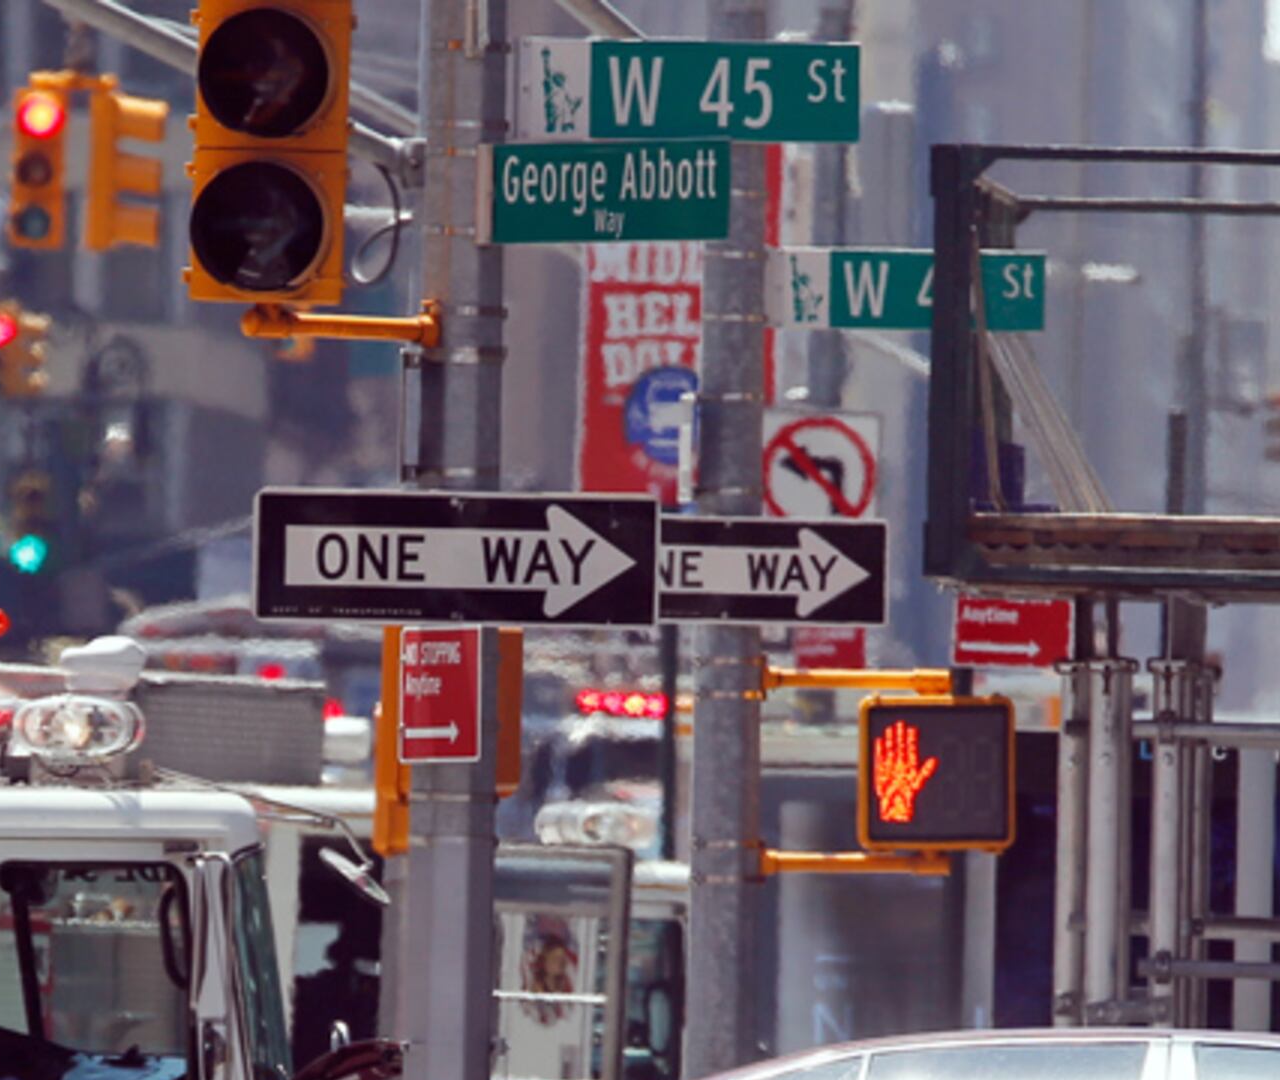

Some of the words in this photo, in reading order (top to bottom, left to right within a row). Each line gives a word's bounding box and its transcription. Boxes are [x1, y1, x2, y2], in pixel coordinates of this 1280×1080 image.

[608, 56, 664, 127] W
[699, 57, 774, 129] 45
[806, 58, 847, 104] St
[502, 154, 608, 216] George
[619, 149, 718, 201] Abbott
[593, 208, 625, 238] Way
[843, 260, 890, 318] W
[1002, 262, 1035, 299] St
[316, 532, 426, 582] ONE
[481, 538, 596, 585] WAY
[658, 550, 704, 588] NE
[746, 552, 839, 592] WAY
[962, 605, 1020, 627] Anytime
